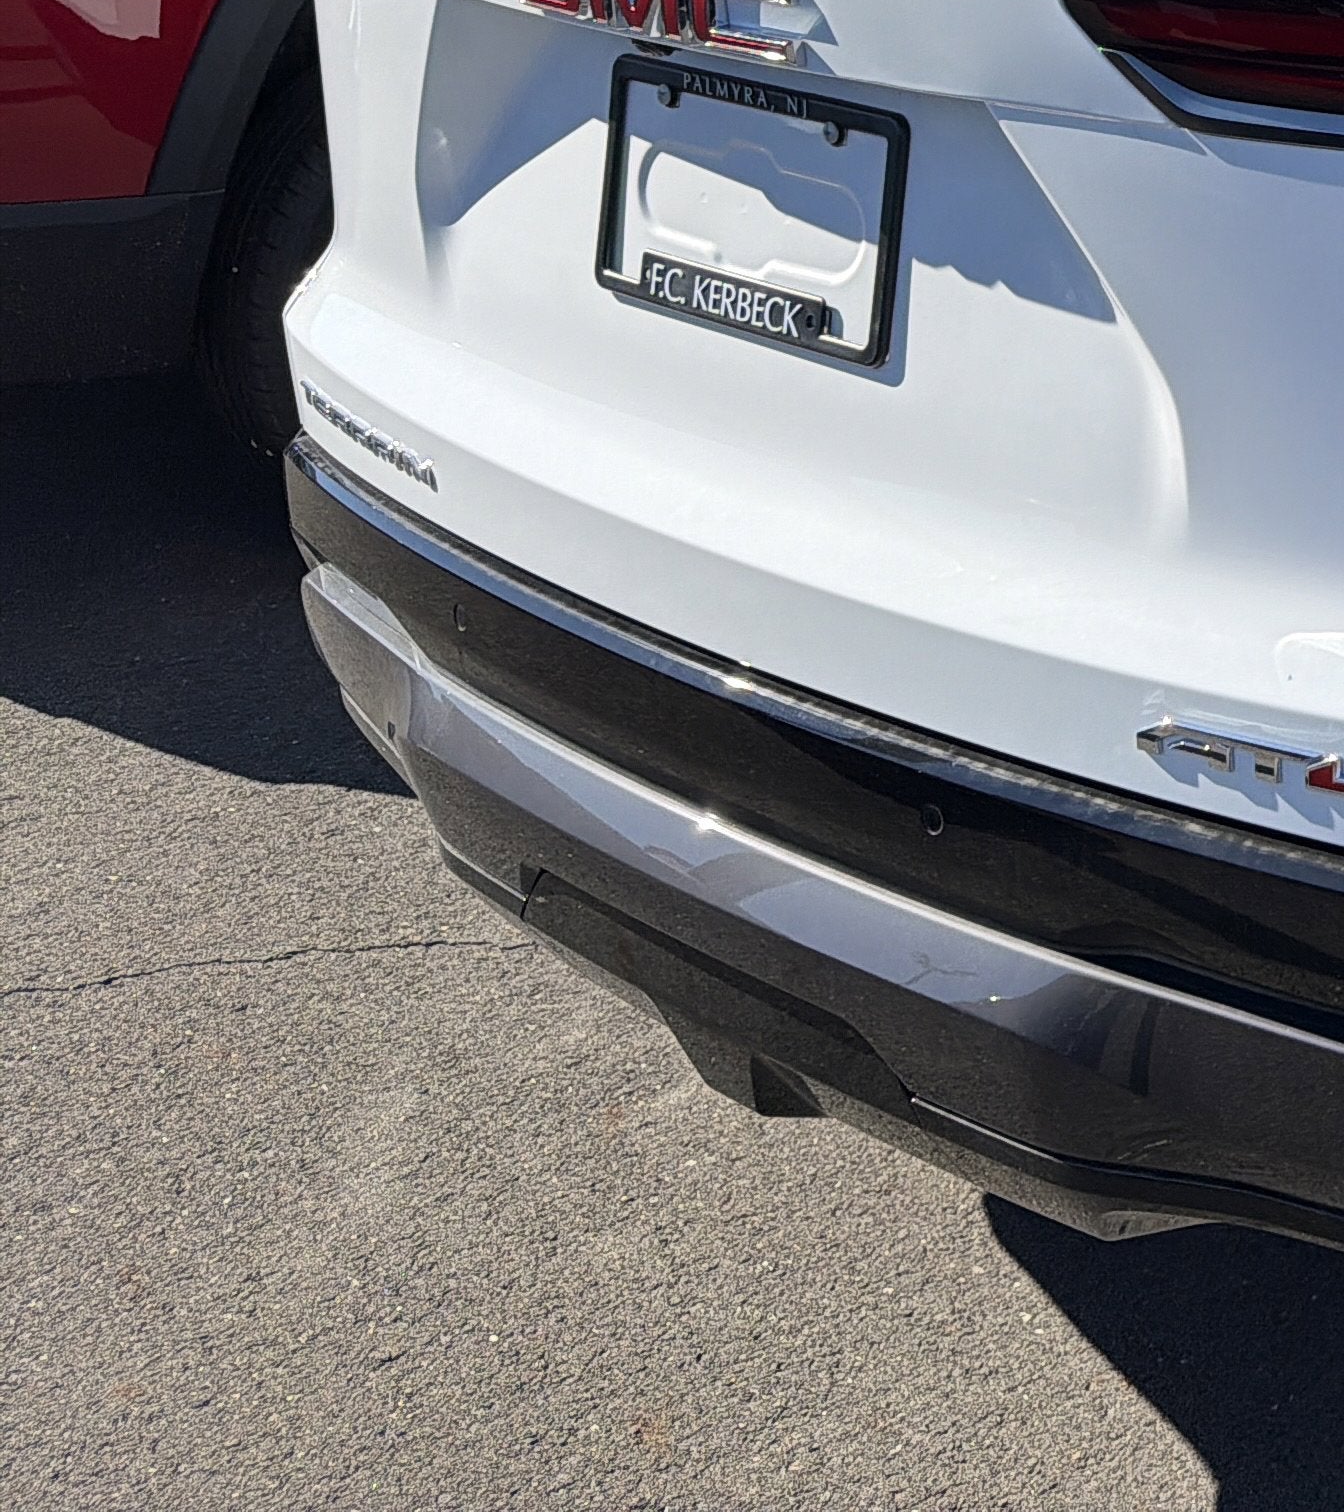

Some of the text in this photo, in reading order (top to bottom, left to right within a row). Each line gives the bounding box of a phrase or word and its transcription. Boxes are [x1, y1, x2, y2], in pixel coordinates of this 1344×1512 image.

[681, 72, 810, 119] PALMYRA, NJ
[648, 262, 804, 338] F.C. KERBECK
